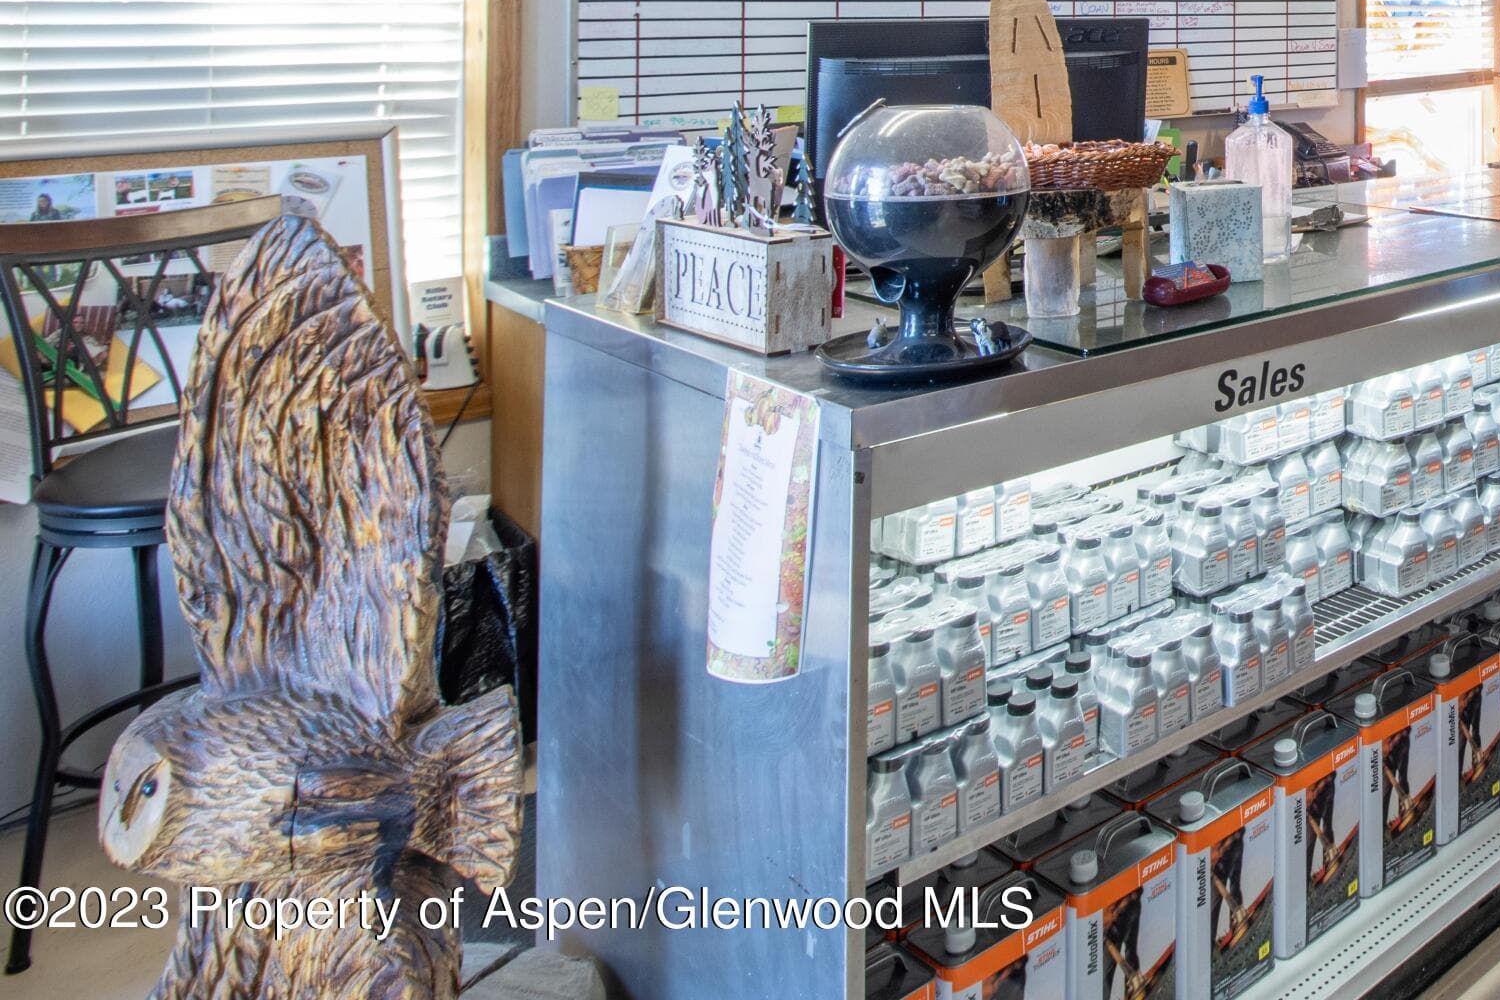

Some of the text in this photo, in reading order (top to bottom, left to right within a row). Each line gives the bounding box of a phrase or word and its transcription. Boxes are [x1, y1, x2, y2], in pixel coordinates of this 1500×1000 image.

[1149, 57, 1170, 65] HOURS
[674, 248, 765, 321] PEACE
[1215, 361, 1306, 413] Sales
[1481, 662, 1499, 677] STIHL
[1409, 703, 1430, 719] STIHL
[1448, 704, 1456, 746] MotoMix
[1335, 745, 1356, 764] STIHL
[1371, 748, 1379, 793] MotoMix
[1244, 799, 1268, 818] STIHL
[1294, 798, 1303, 845] MotoMix
[1142, 855, 1169, 878] STIHL
[1197, 856, 1207, 908] MotoMix
[1026, 919, 1058, 945] STIHL
[1087, 920, 1099, 976] MotoMix
